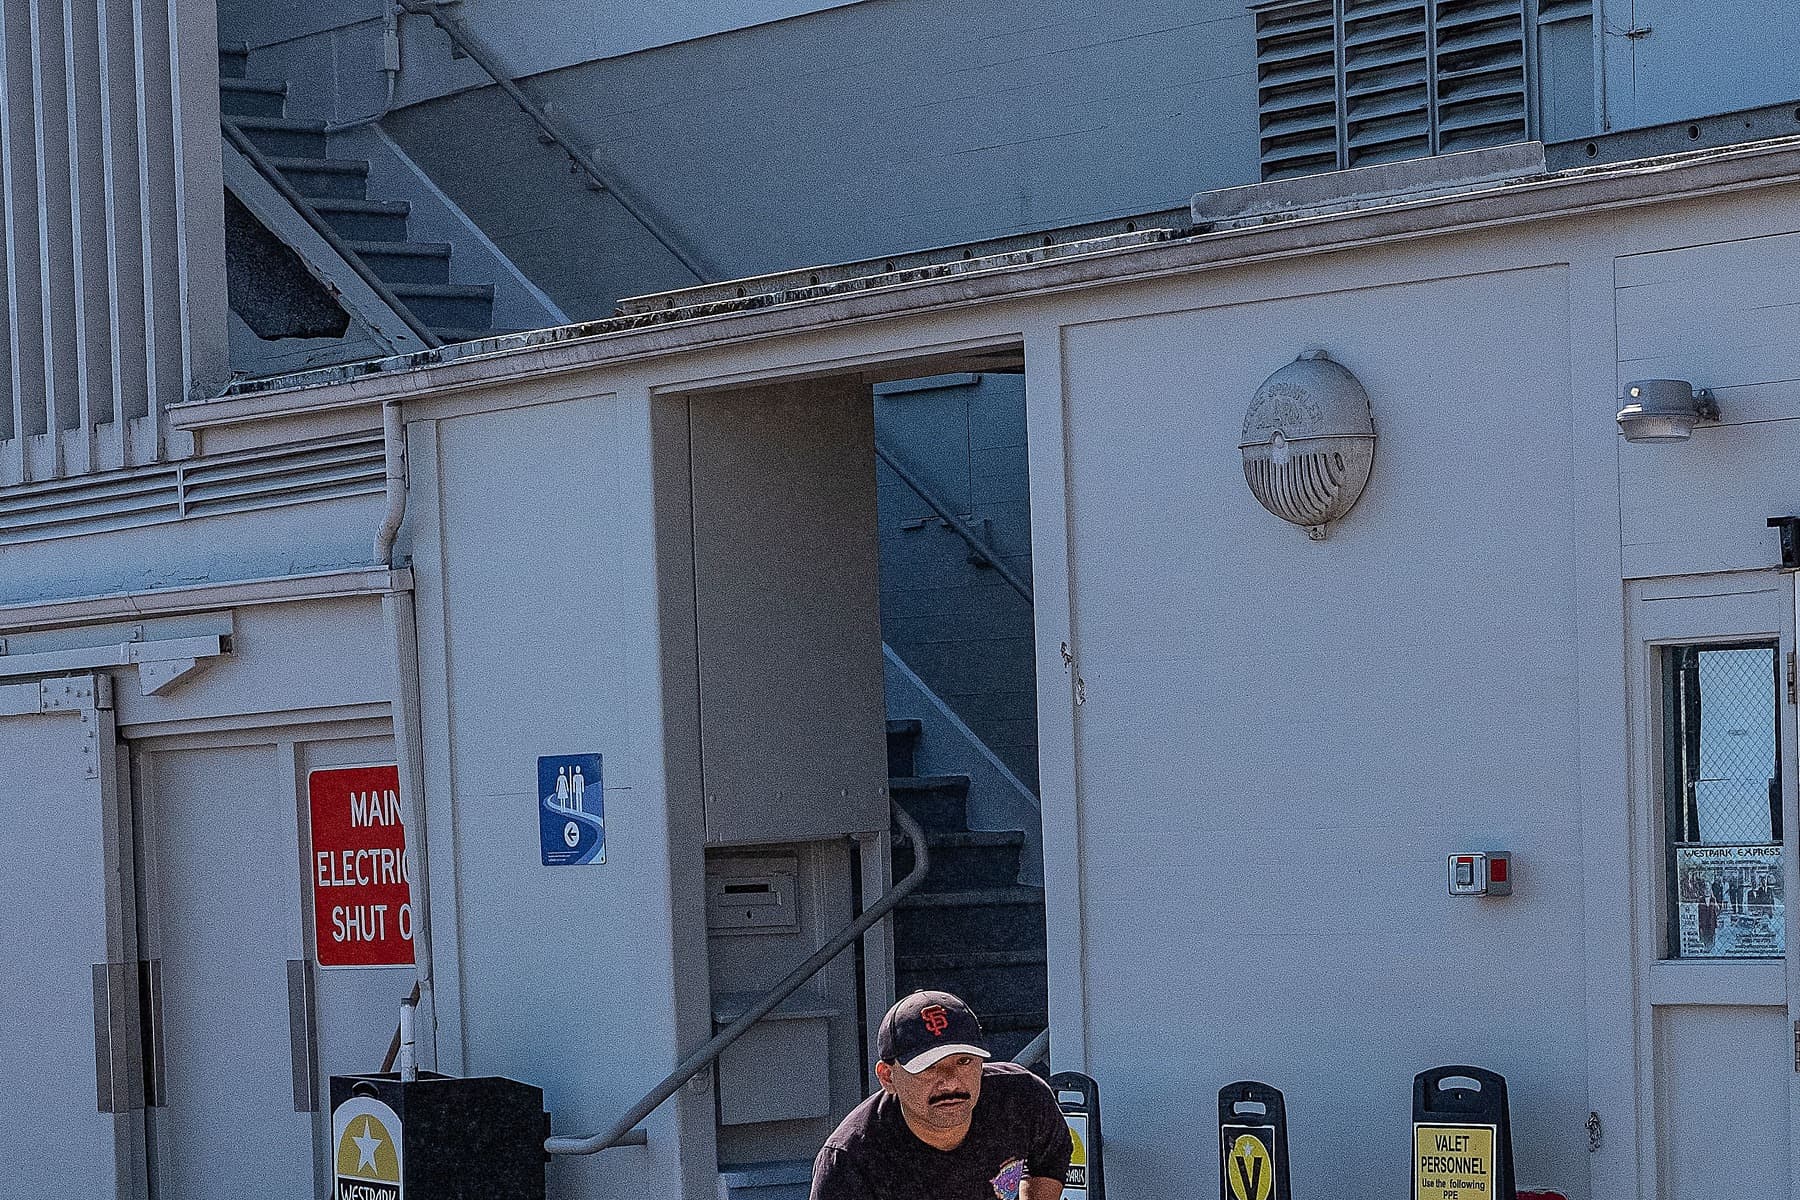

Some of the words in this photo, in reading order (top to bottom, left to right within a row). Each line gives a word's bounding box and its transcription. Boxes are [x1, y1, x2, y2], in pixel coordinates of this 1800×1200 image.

[351, 789, 404, 827] MAIN
[1684, 848, 1733, 858] WESTPARK
[1737, 847, 1781, 857] EXPRESS
[332, 904, 387, 942] SHUT
[920, 1004, 948, 1037] SF
[1435, 1134, 1470, 1152] VALET
[1421, 1155, 1487, 1175] PERSONNEL
[1422, 1178, 1435, 1188] Use
[1435, 1178, 1447, 1188] the
[1449, 1178, 1486, 1192] following
[1443, 1190, 1459, 1200] PPE
